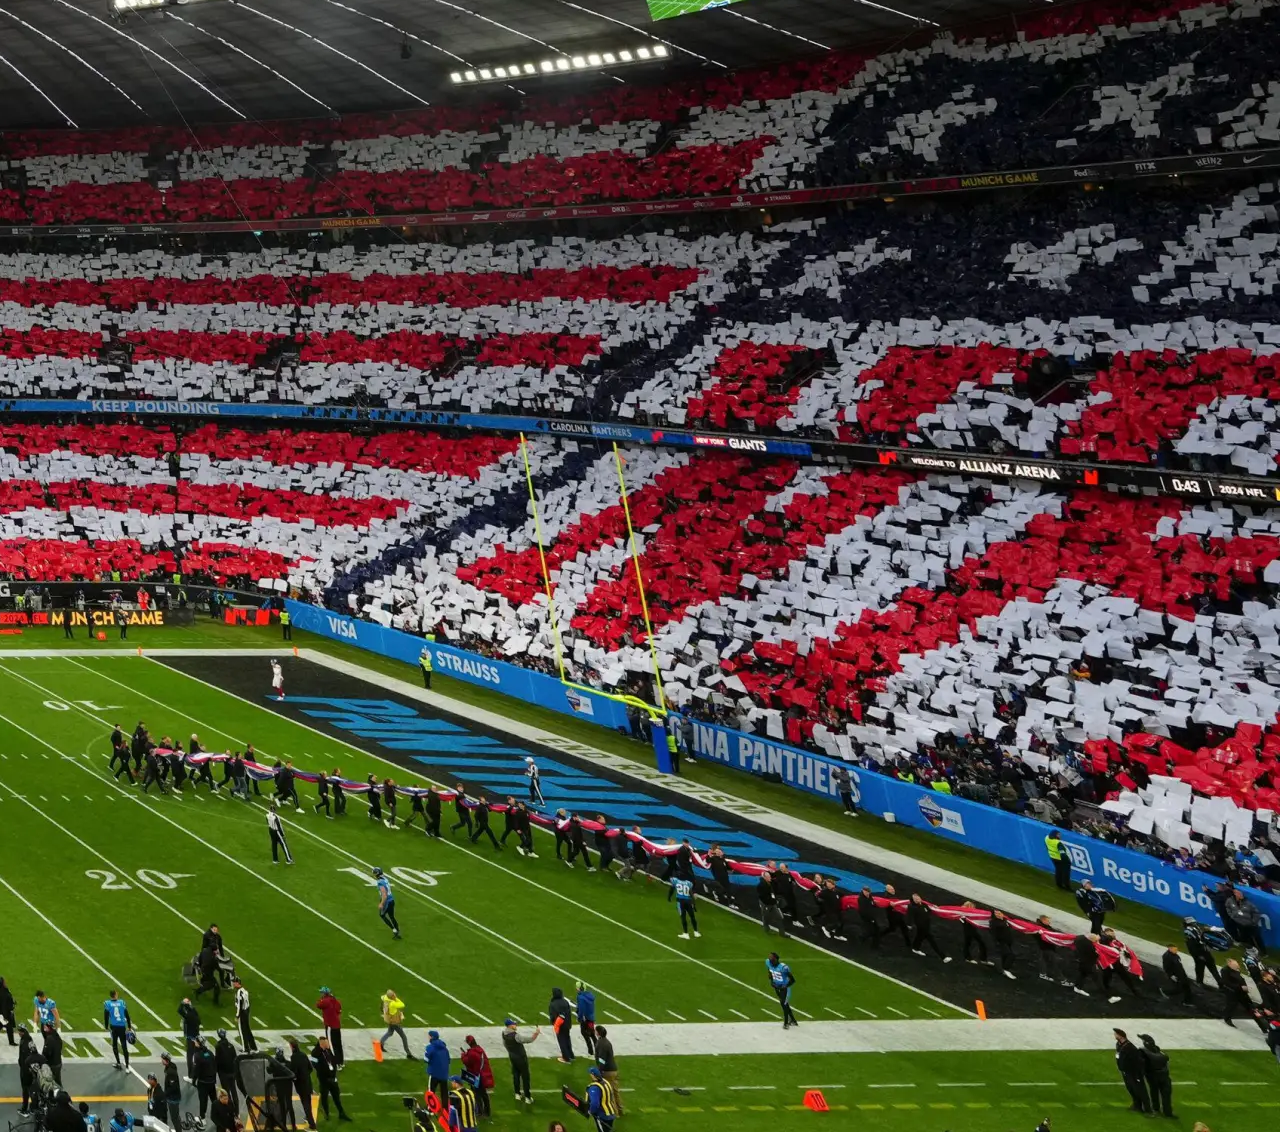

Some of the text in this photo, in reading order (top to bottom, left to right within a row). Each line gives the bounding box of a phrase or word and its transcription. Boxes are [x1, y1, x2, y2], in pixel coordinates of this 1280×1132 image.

[1195, 157, 1223, 167] HEINZ
[961, 172, 1040, 188] MUNICH GAME
[322, 219, 357, 227] MUNICH
[91, 400, 220, 414] KEEP POUNDING
[551, 422, 633, 438] CAROLINA PANTHERS
[728, 438, 767, 451] GIANTS
[911, 457, 1061, 480] WELCOME TO ALLIANZ ARENA
[1172, 479, 1201, 493] 0:43
[1218, 485, 1267, 498] 2024 NFL
[326, 615, 358, 640] VISA
[435, 650, 501, 685] STRAUSS
[541, 736, 771, 816] END RACISM
[85, 868, 178, 890] 20
[1102, 857, 1171, 900] Regio
[811, 1092, 824, 1108] 10
